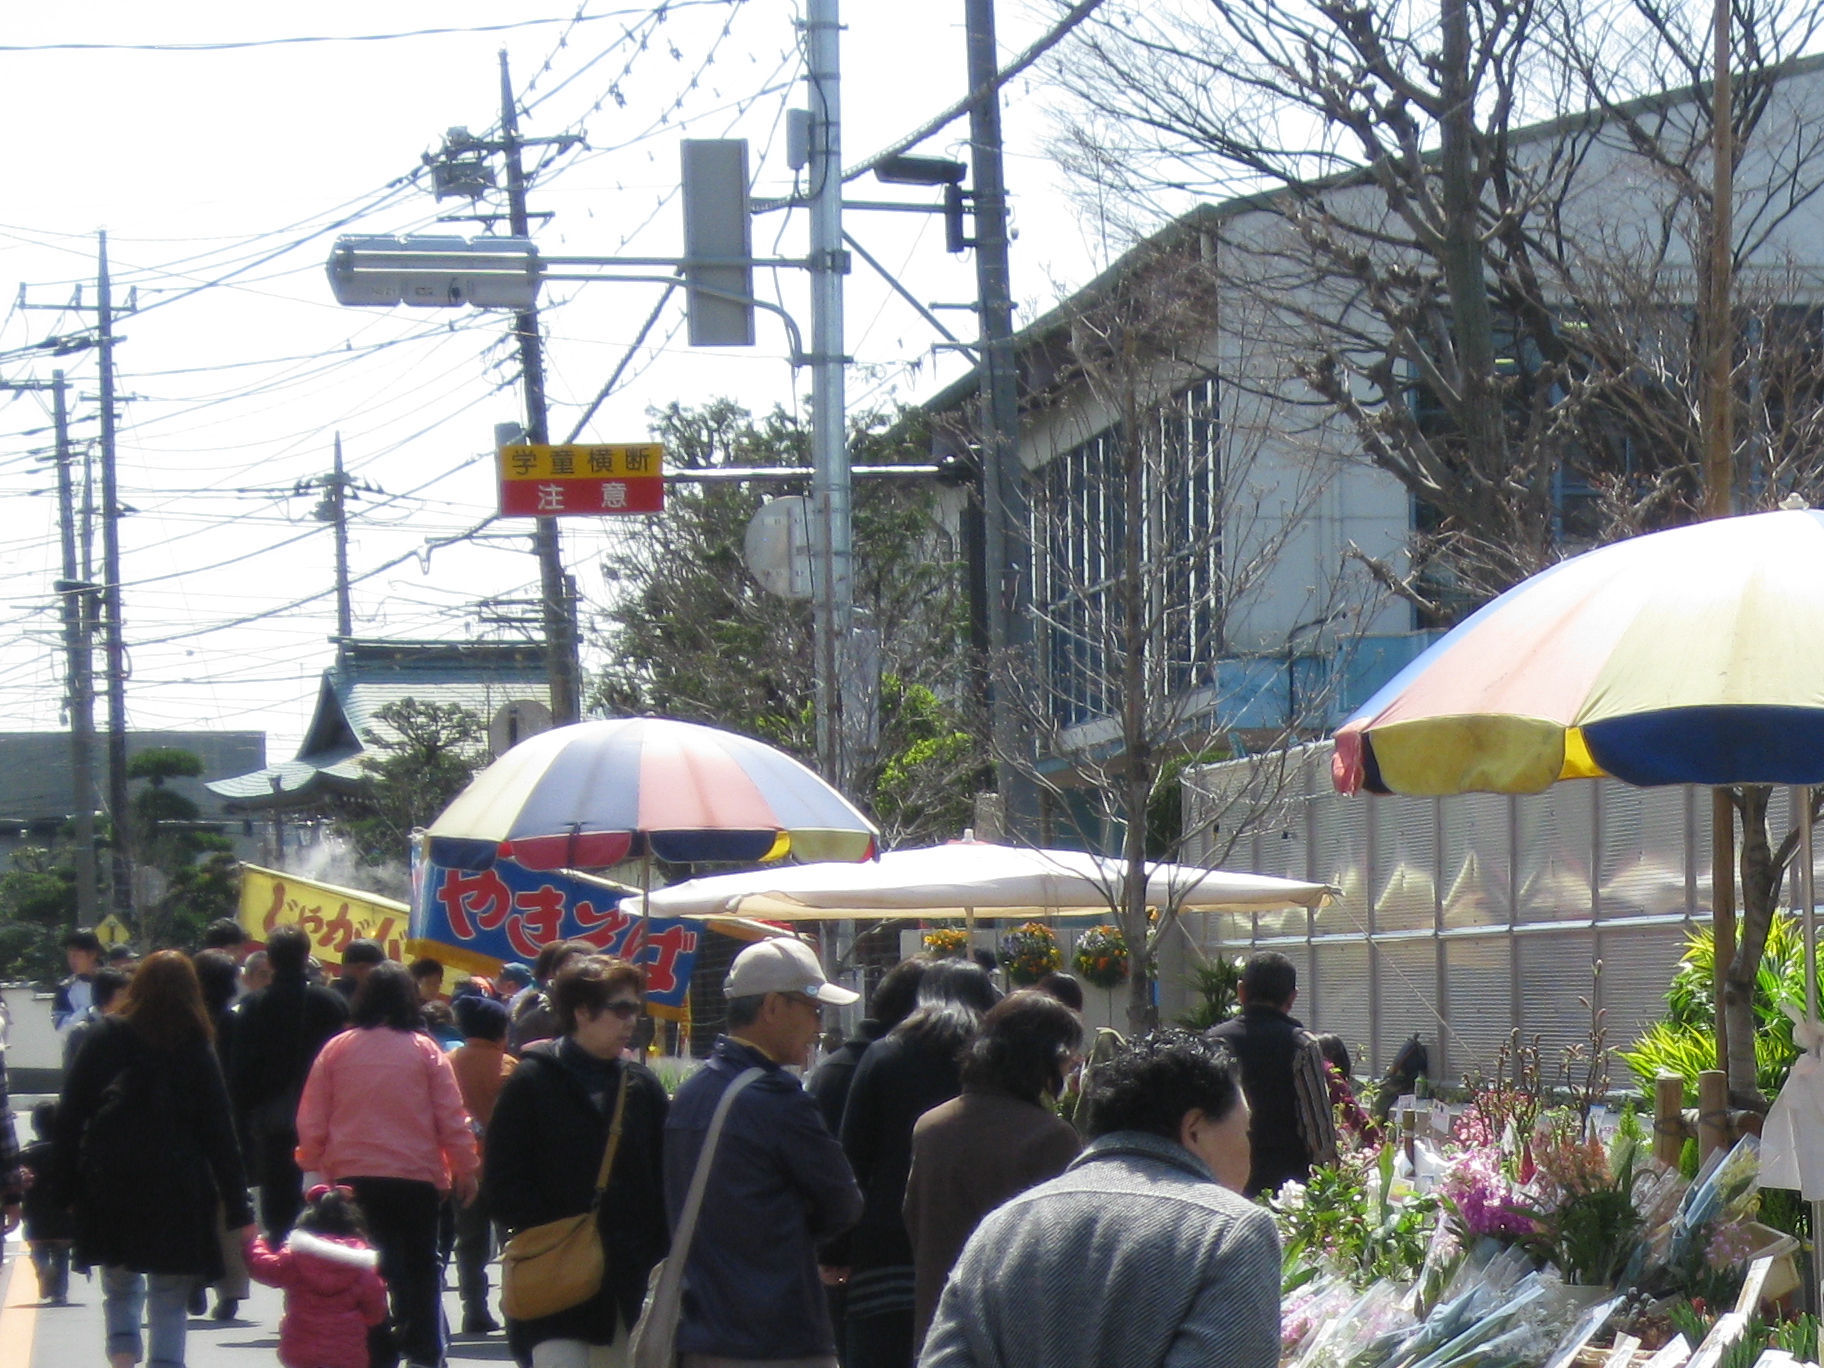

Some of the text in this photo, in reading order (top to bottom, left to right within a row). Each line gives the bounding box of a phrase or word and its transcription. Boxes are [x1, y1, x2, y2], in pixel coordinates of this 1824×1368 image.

[512, 447, 650, 476] 学童横断
[538, 482, 628, 511] 注意
[436, 868, 698, 993] やきそば
